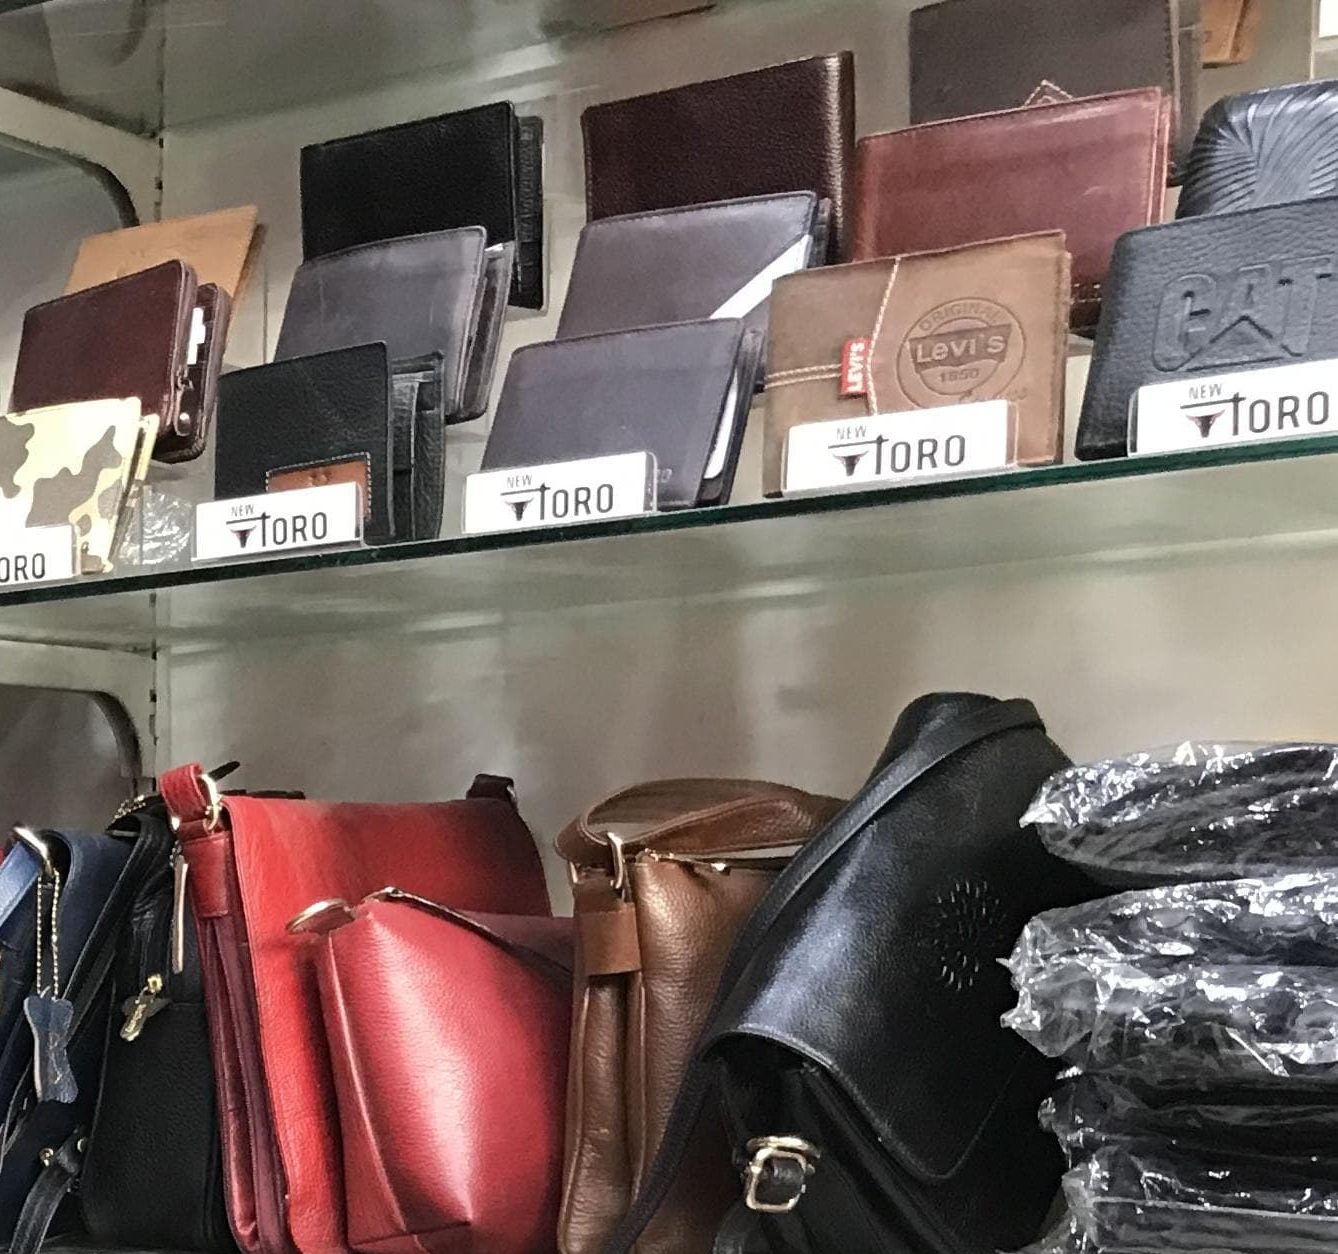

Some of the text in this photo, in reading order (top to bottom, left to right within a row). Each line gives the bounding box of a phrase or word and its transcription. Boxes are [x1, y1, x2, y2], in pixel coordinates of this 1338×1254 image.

[1153, 253, 1334, 372] CAT
[916, 335, 1005, 363] Levi's
[1188, 383, 1223, 400] NEW
[1231, 391, 1330, 436] TORO
[836, 425, 868, 439] NEW
[874, 434, 966, 475] TORO
[506, 474, 533, 488] NEW
[231, 504, 254, 518] NEW
[539, 483, 614, 521] TORO
[260, 512, 328, 548] TORO
